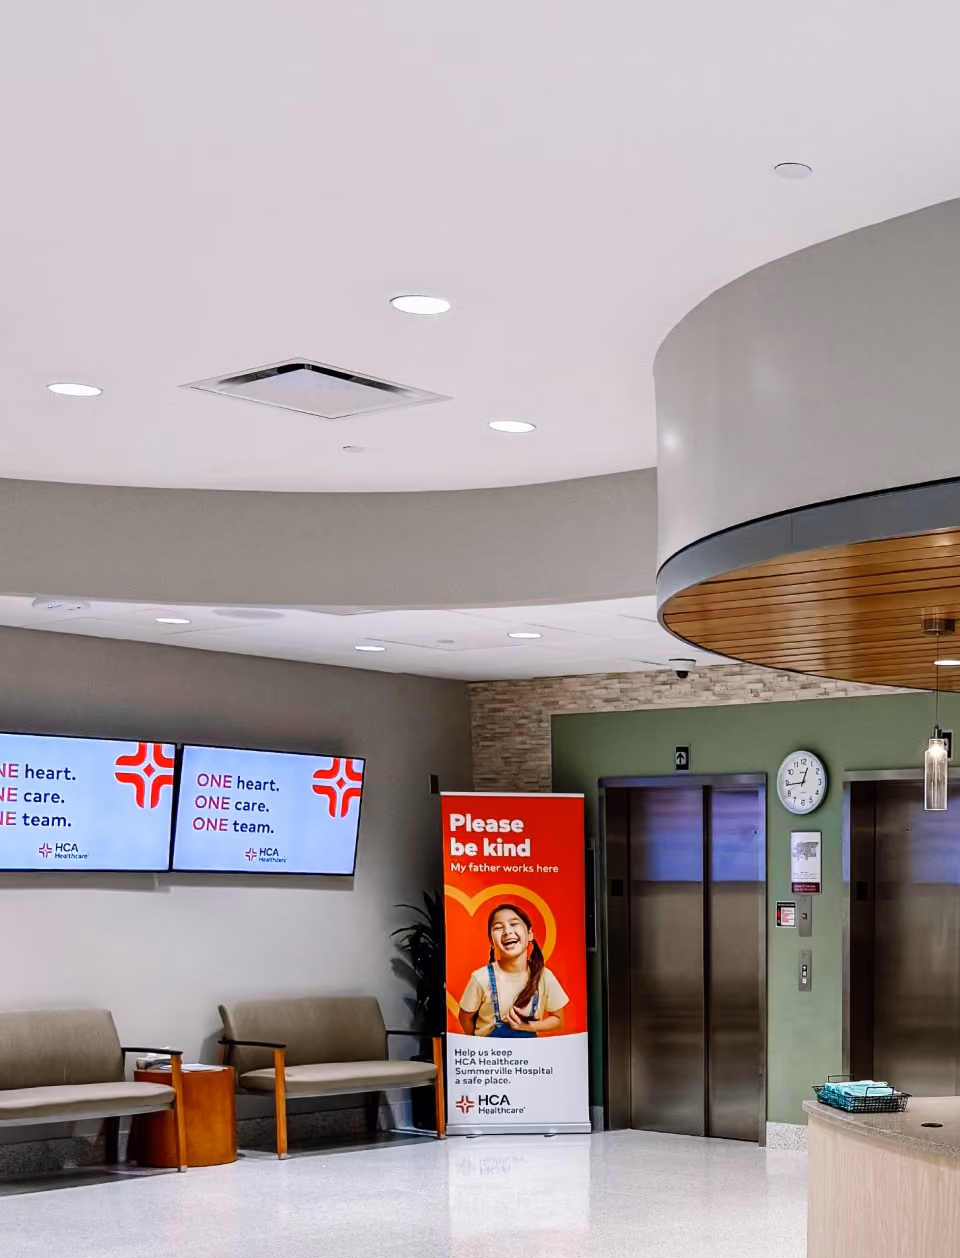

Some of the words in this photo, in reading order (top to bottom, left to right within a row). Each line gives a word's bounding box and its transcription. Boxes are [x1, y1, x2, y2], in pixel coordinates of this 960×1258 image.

[800, 758, 807, 766] 12
[24, 763, 76, 781] heart.
[815, 767, 820, 775] 2
[196, 773, 233, 789] ONE
[237, 775, 280, 792] heart.
[23, 791, 65, 804] care.
[194, 795, 231, 811] ONE
[234, 800, 270, 813] care.
[22, 813, 72, 827] team.
[192, 816, 229, 832] ONE
[232, 819, 275, 834] team.
[449, 813, 524, 833] Please
[55, 842, 79, 853] HCA
[259, 847, 279, 857] HCA
[450, 837, 478, 856] be
[483, 837, 531, 857] kind
[450, 862, 466, 874] My
[468, 862, 500, 873] father
[503, 863, 534, 873] works
[536, 864, 559, 873] here
[454, 1048, 476, 1057] Help
[491, 1048, 513, 1057] keep
[455, 1058, 476, 1066] HCA
[478, 1058, 529, 1066] Healthcare
[455, 1067, 513, 1075] Summerville
[515, 1067, 553, 1076] Hospital
[462, 1076, 482, 1085] safe
[484, 1076, 511, 1085] place.
[478, 1094, 511, 1106] HCA
[478, 1106, 524, 1115] Healthcare
